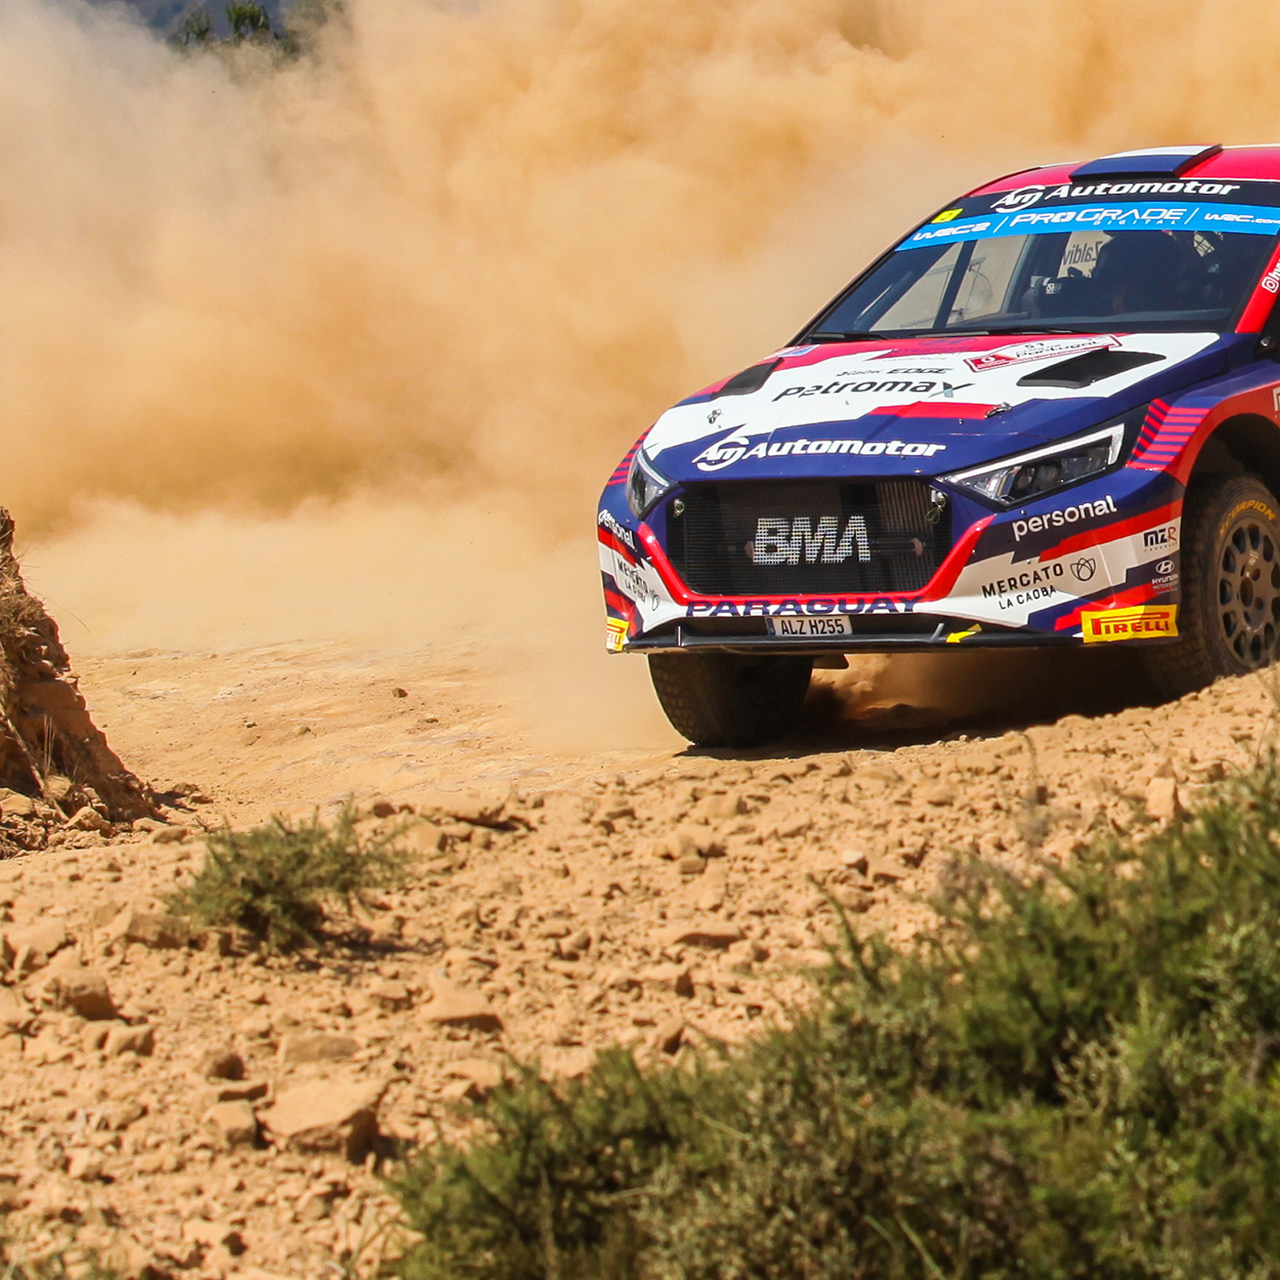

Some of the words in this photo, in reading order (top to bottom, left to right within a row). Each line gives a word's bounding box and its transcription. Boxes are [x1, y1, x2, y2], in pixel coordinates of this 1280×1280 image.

[1044, 181, 1240, 200] Automotor
[741, 439, 947, 459] Automotor
[598, 508, 635, 549] personal
[1012, 495, 1118, 542] personal
[753, 516, 871, 565] BMA
[981, 563, 1064, 599] MERCATO
[686, 596, 925, 617] PARAGUAY
[999, 599, 1014, 610] LA
[1016, 585, 1057, 605] CAOBA
[780, 620, 810, 636] ALZ
[811, 618, 845, 634] H255
[1090, 612, 1170, 635] PIRELLI
